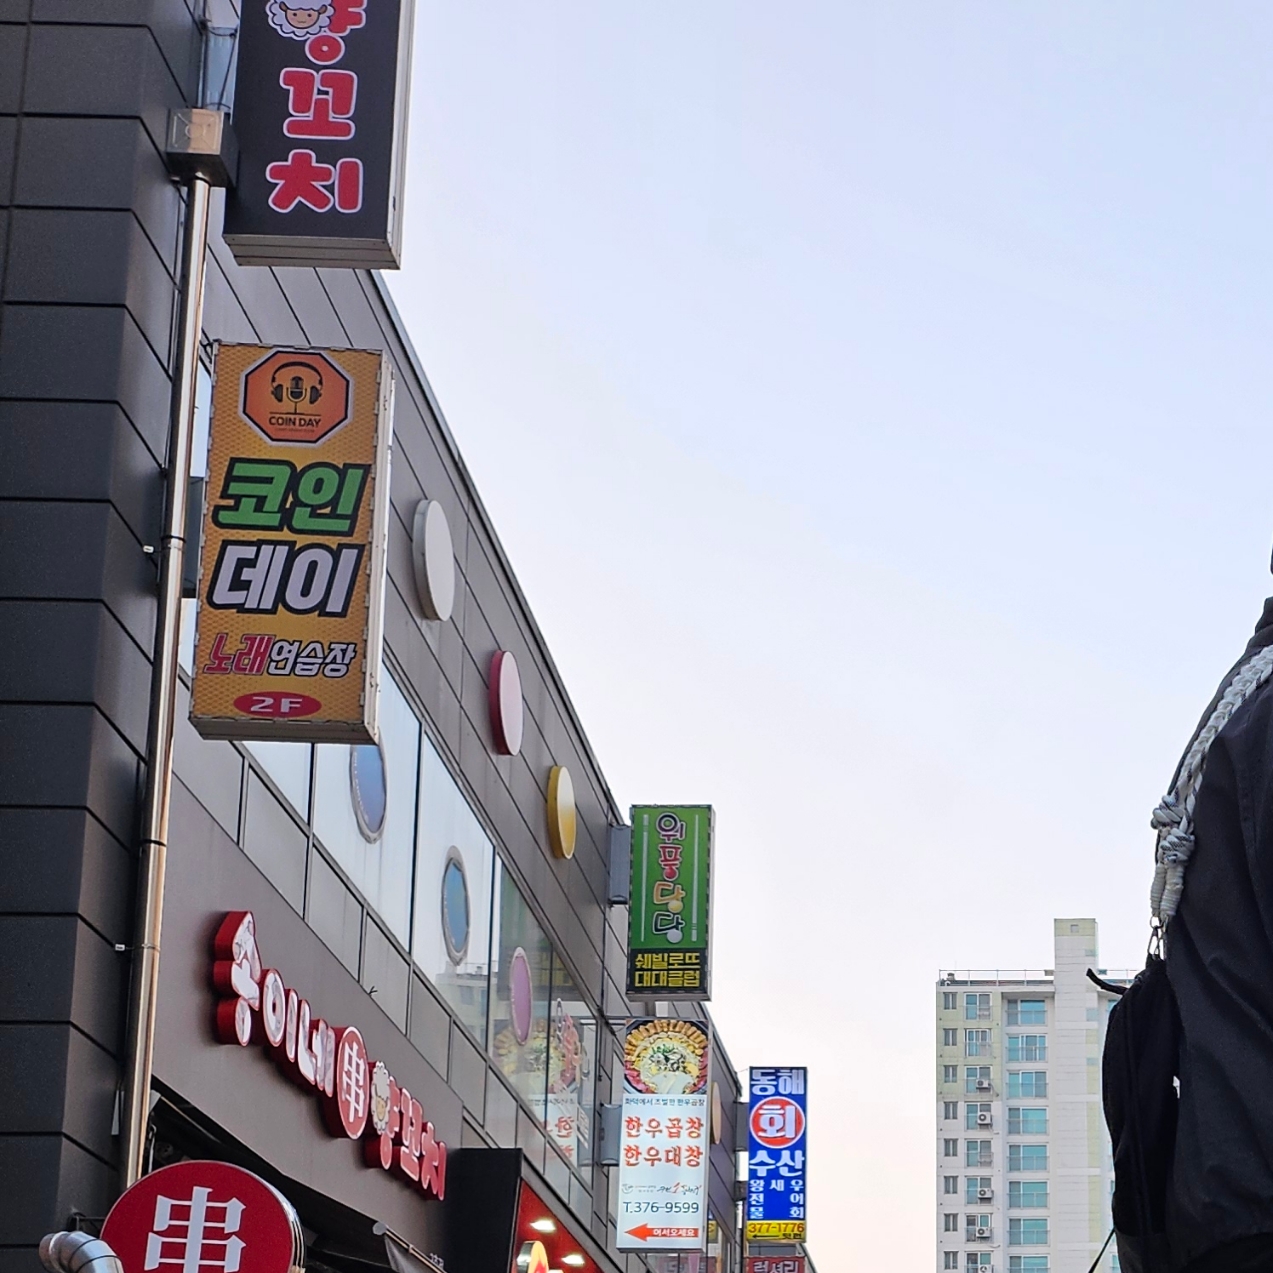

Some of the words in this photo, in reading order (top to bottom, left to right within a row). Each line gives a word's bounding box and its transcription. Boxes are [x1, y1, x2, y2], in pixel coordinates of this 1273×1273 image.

[268, 415, 297, 427] COIN
[298, 416, 322, 428] DAY
[212, 457, 370, 536] 코인
[207, 540, 365, 617] 데이
[203, 633, 357, 678] 노래연습장
[249, 696, 302, 713] 2F
[751, 1069, 804, 1095] 동해
[624, 1116, 704, 1139] 한우곱창
[758, 1104, 795, 1139] 회
[623, 1144, 703, 1167] 한우대창
[750, 1150, 804, 1176] 수산
[623, 1201, 699, 1213] T.376-9599
[653, 1228, 695, 1237] 어서오세요
[748, 1222, 805, 1233] 377-1776
